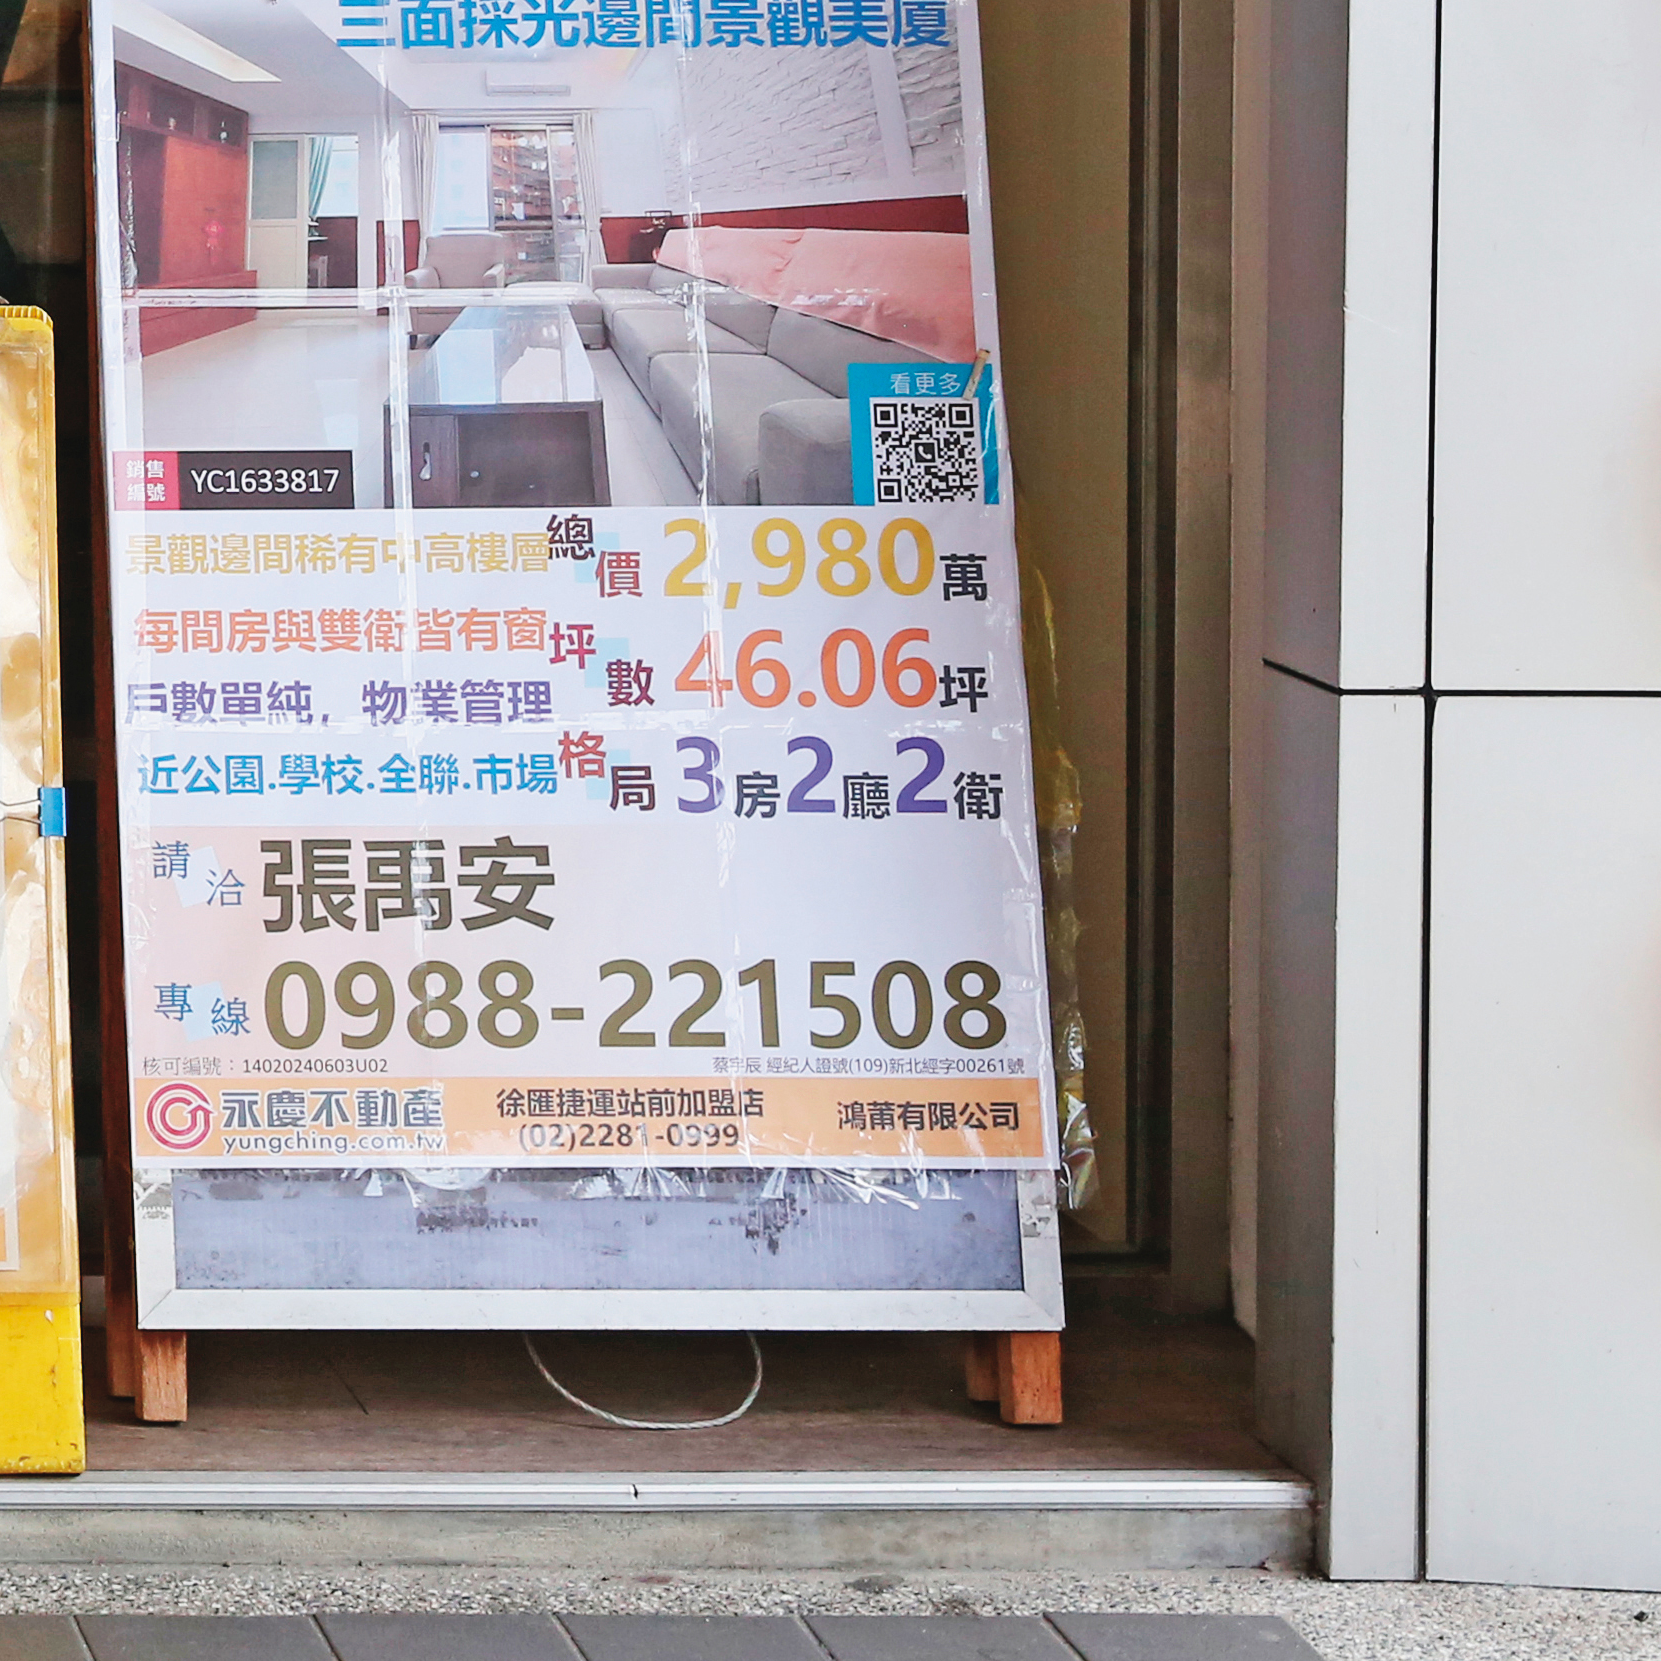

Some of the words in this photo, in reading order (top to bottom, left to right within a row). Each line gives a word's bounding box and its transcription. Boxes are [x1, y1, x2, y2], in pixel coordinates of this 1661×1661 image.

[889, 372, 962, 394] 看更多
[126, 459, 166, 480] 銷售
[190, 468, 340, 495] YC1633817
[127, 482, 166, 503] 編號
[124, 532, 550, 577] 景觀邊間稀有中高樓層
[134, 607, 548, 654] 每間房與雙衛皆有窗
[137, 753, 558, 797] 近公園.學校.全聯.市場
[262, 836, 555, 934] 張禹安
[263, 958, 1008, 1051] 0988-221508
[222, 1090, 444, 1130] 永慶不動產
[496, 1090, 765, 1119] 徐匯捷運站前加盟店
[837, 1100, 1020, 1132] 鴻莆有限公司
[222, 1133, 444, 1154] yungching.com.tw
[518, 1122, 740, 1151] (02)2281-0999
